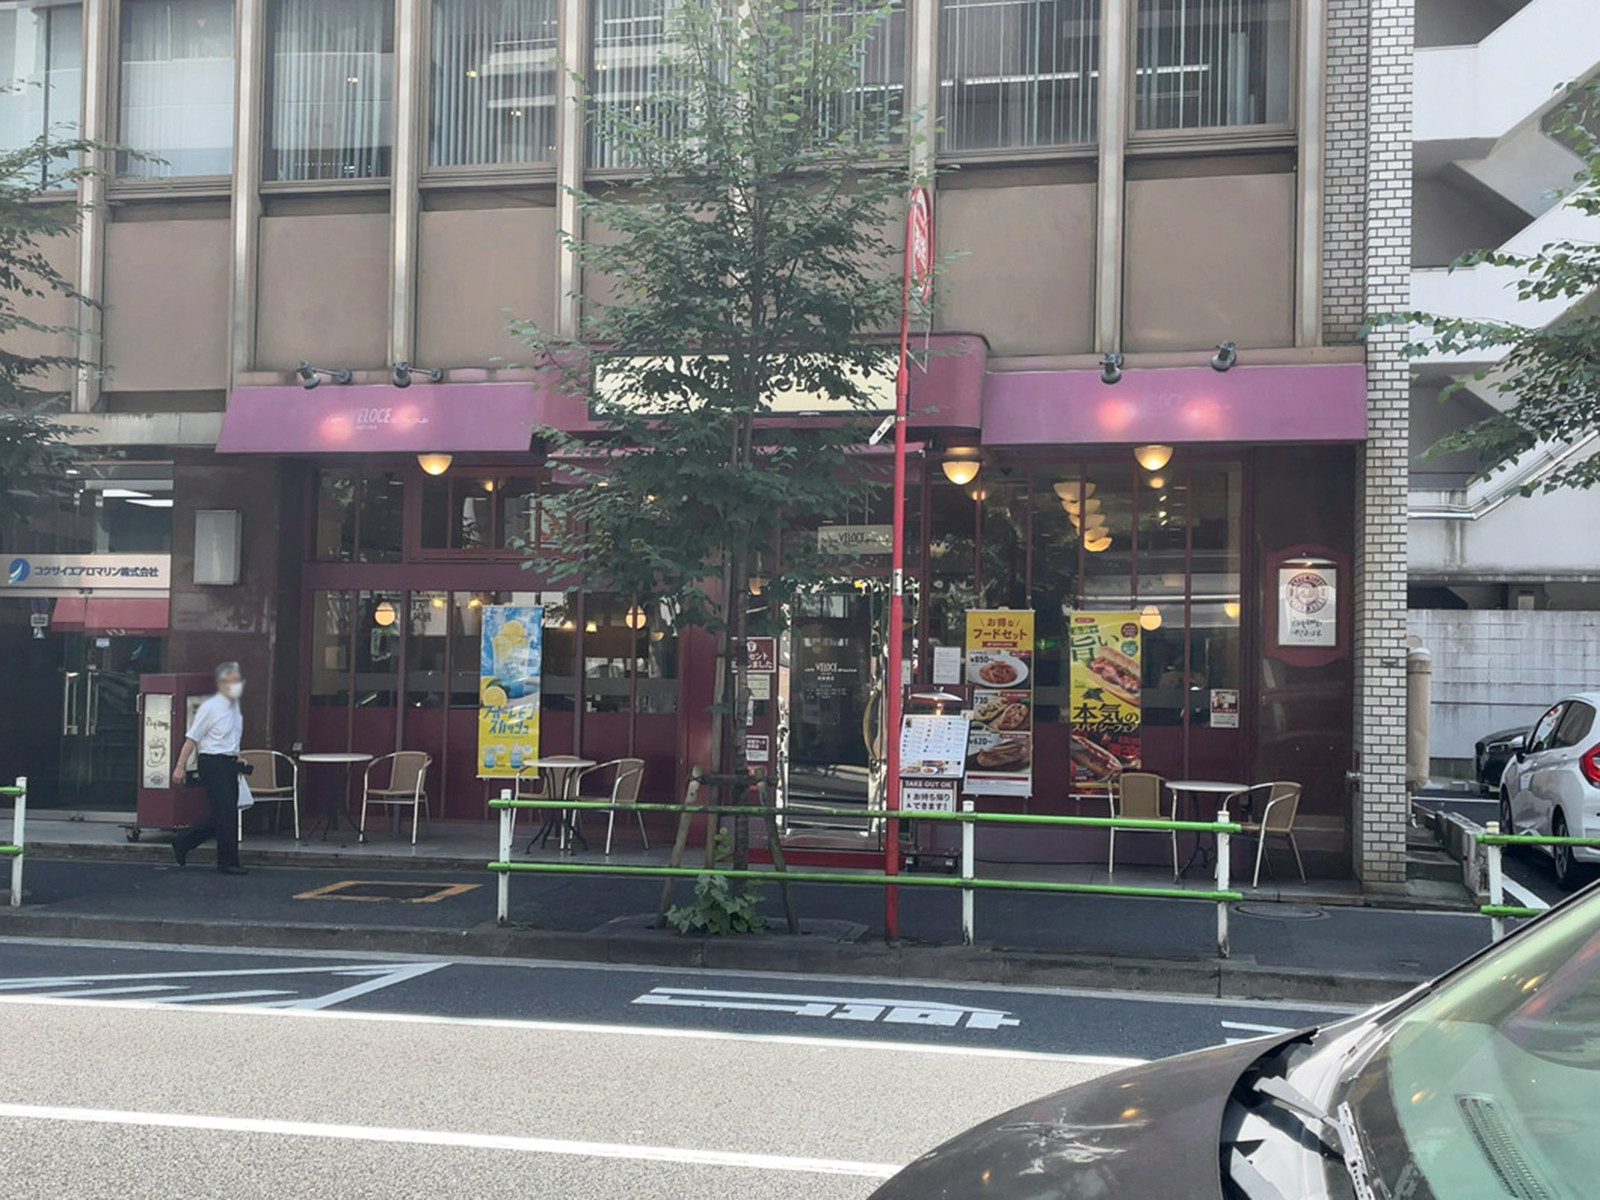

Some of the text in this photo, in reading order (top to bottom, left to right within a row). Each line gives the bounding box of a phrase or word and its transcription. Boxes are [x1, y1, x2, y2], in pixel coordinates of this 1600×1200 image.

[35, 566, 159, 578] コクサイエアロマリン株式会社
[973, 629, 1027, 641] フードセット
[1073, 702, 1139, 722] 本気の
[923, 780, 939, 788] OUT
